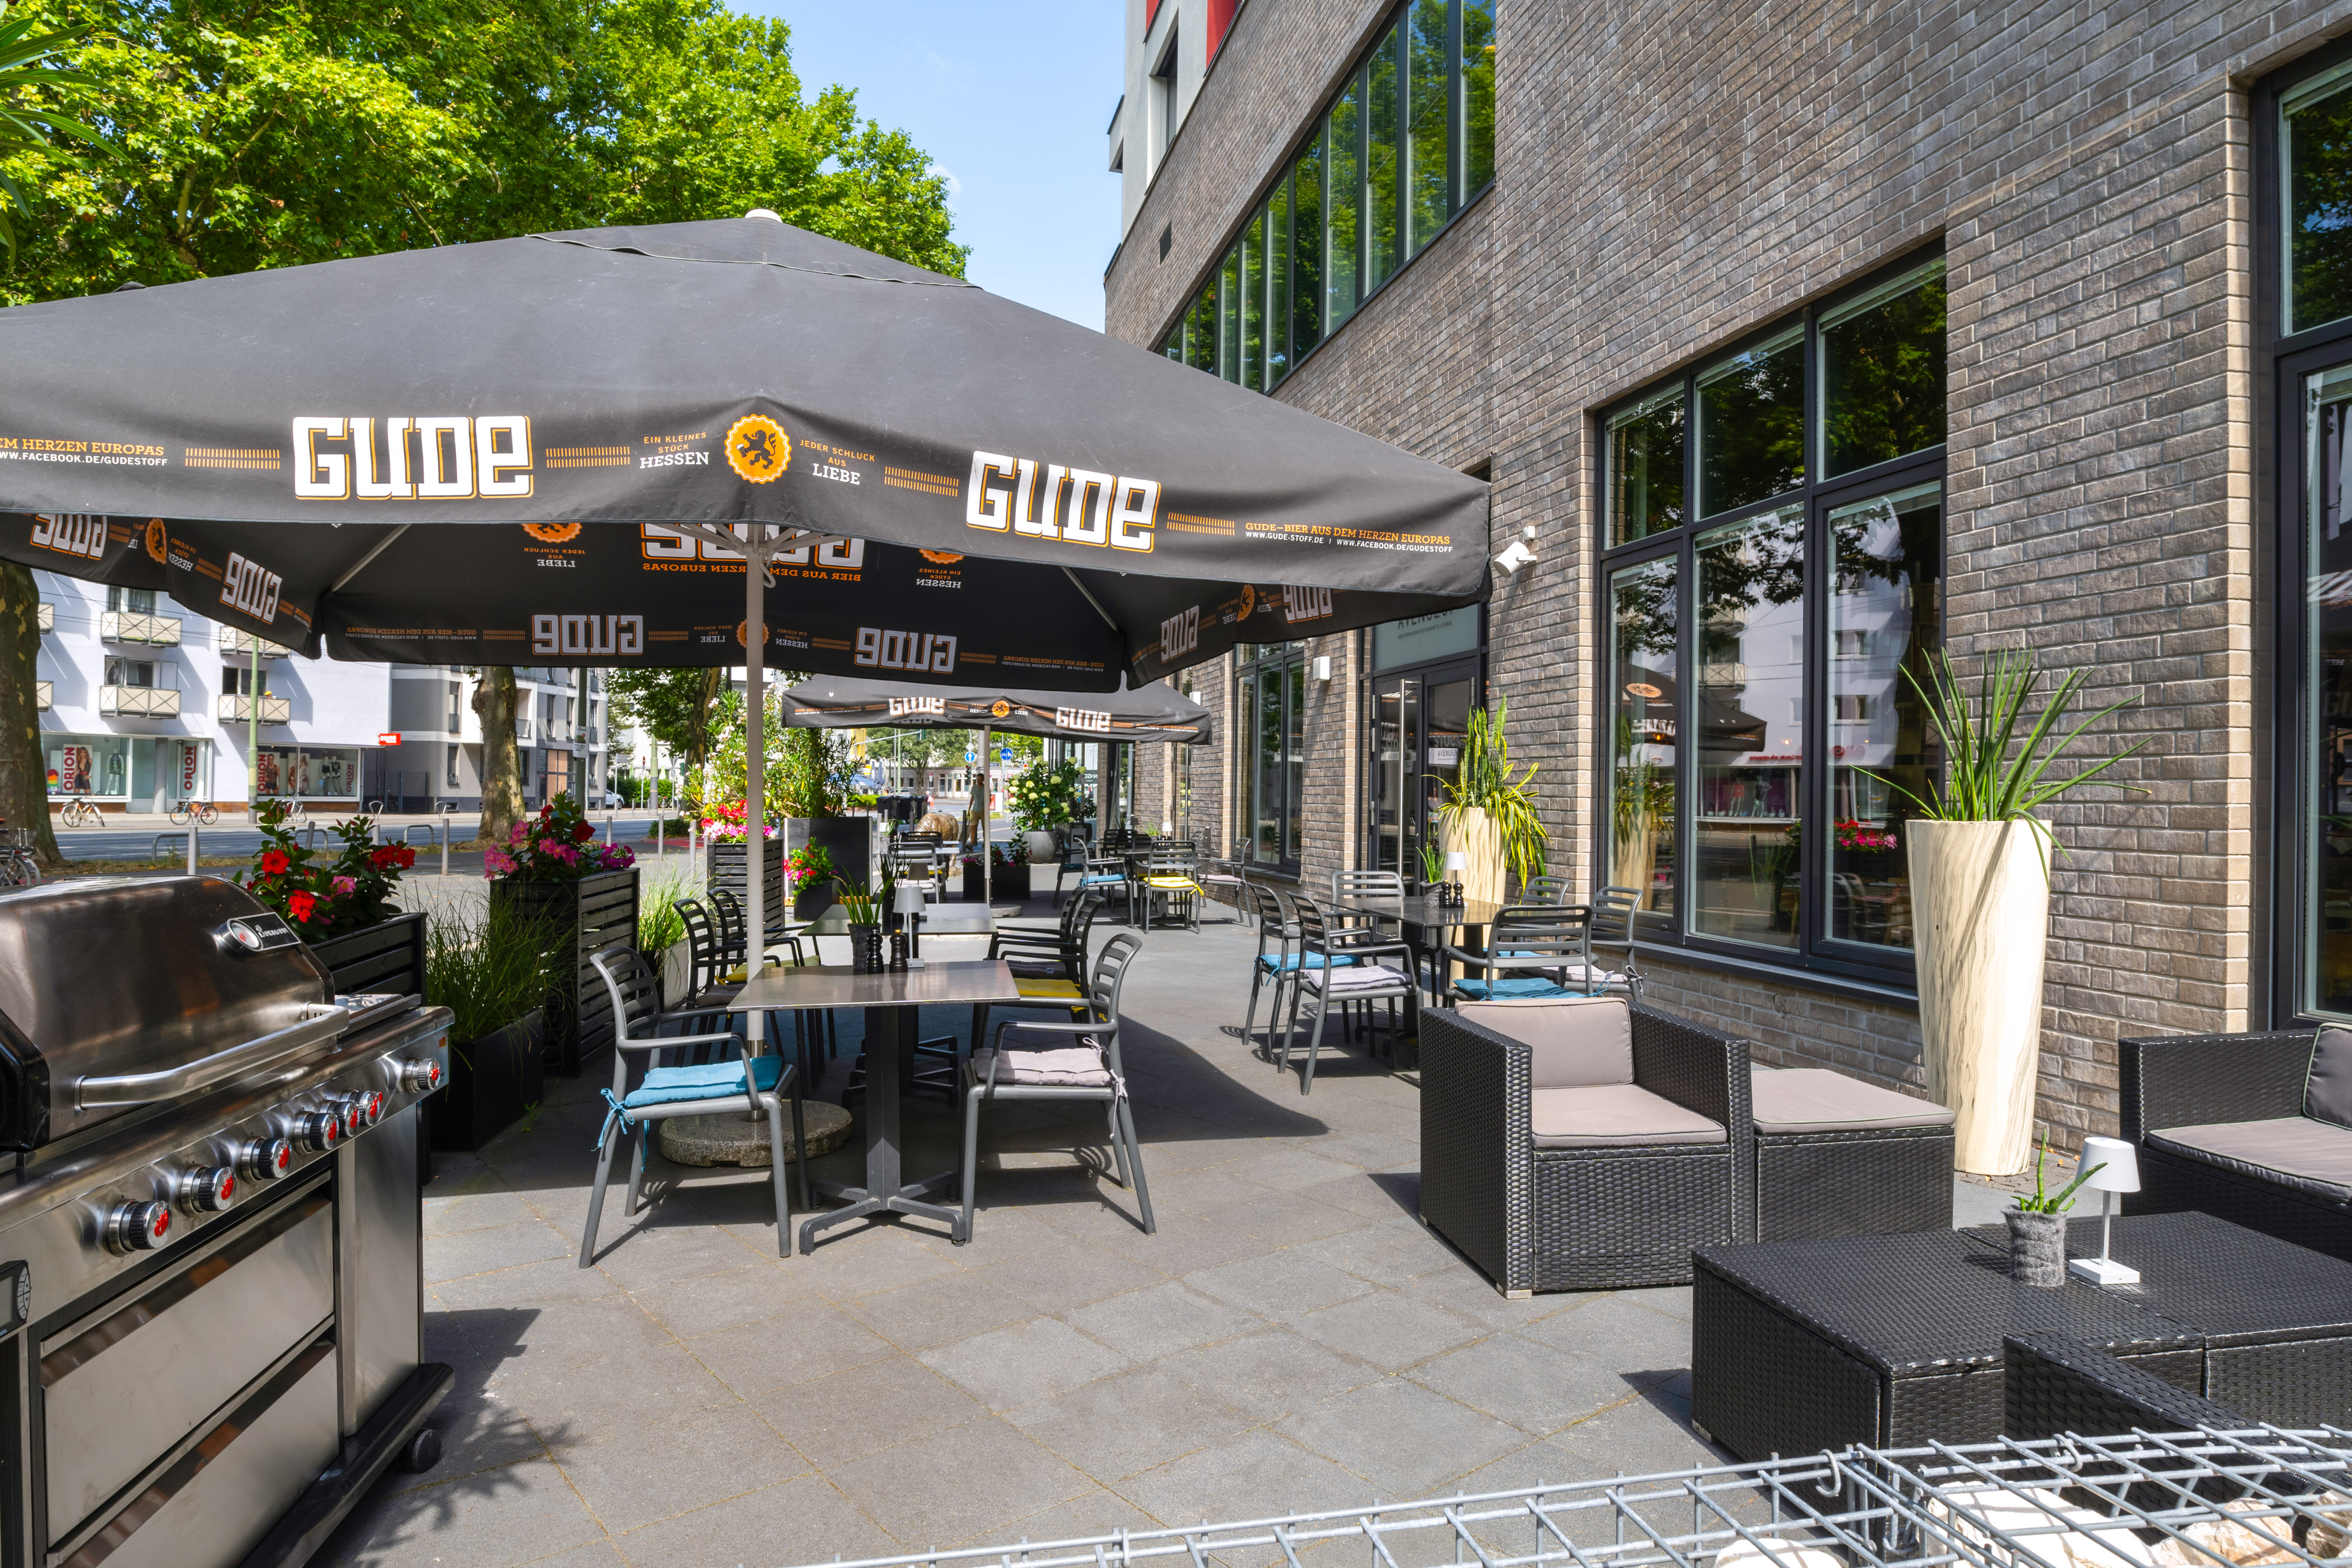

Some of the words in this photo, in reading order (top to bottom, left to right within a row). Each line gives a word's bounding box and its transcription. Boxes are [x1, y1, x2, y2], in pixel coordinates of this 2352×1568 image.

[644, 436, 661, 444] EIN
[665, 432, 707, 443] KLEINES
[22, 439, 88, 452] HERZEN
[91, 442, 164, 456] EUROPAS
[658, 444, 689, 453] STÜCK
[800, 439, 829, 452] JEDER
[832, 447, 875, 462] SCHLUCK
[639, 452, 709, 469] HESSEN
[828, 457, 846, 467] AUS
[812, 463, 860, 485] LIEBE
[1245, 531, 1324, 544] WWW.GUDE-STOFF.DE
[1337, 538, 1453, 552] WWW.FACEBOOK.DE/GUDESTOFF
[1310, 525, 1332, 535] AUS
[1333, 527, 1357, 538] DEM
[1358, 529, 1399, 542] HERZEN
[1401, 534, 1450, 545] EUROPAS
[380, 735, 397, 743] ORION
[63, 747, 75, 791] ORION
[184, 746, 194, 791] ORION
